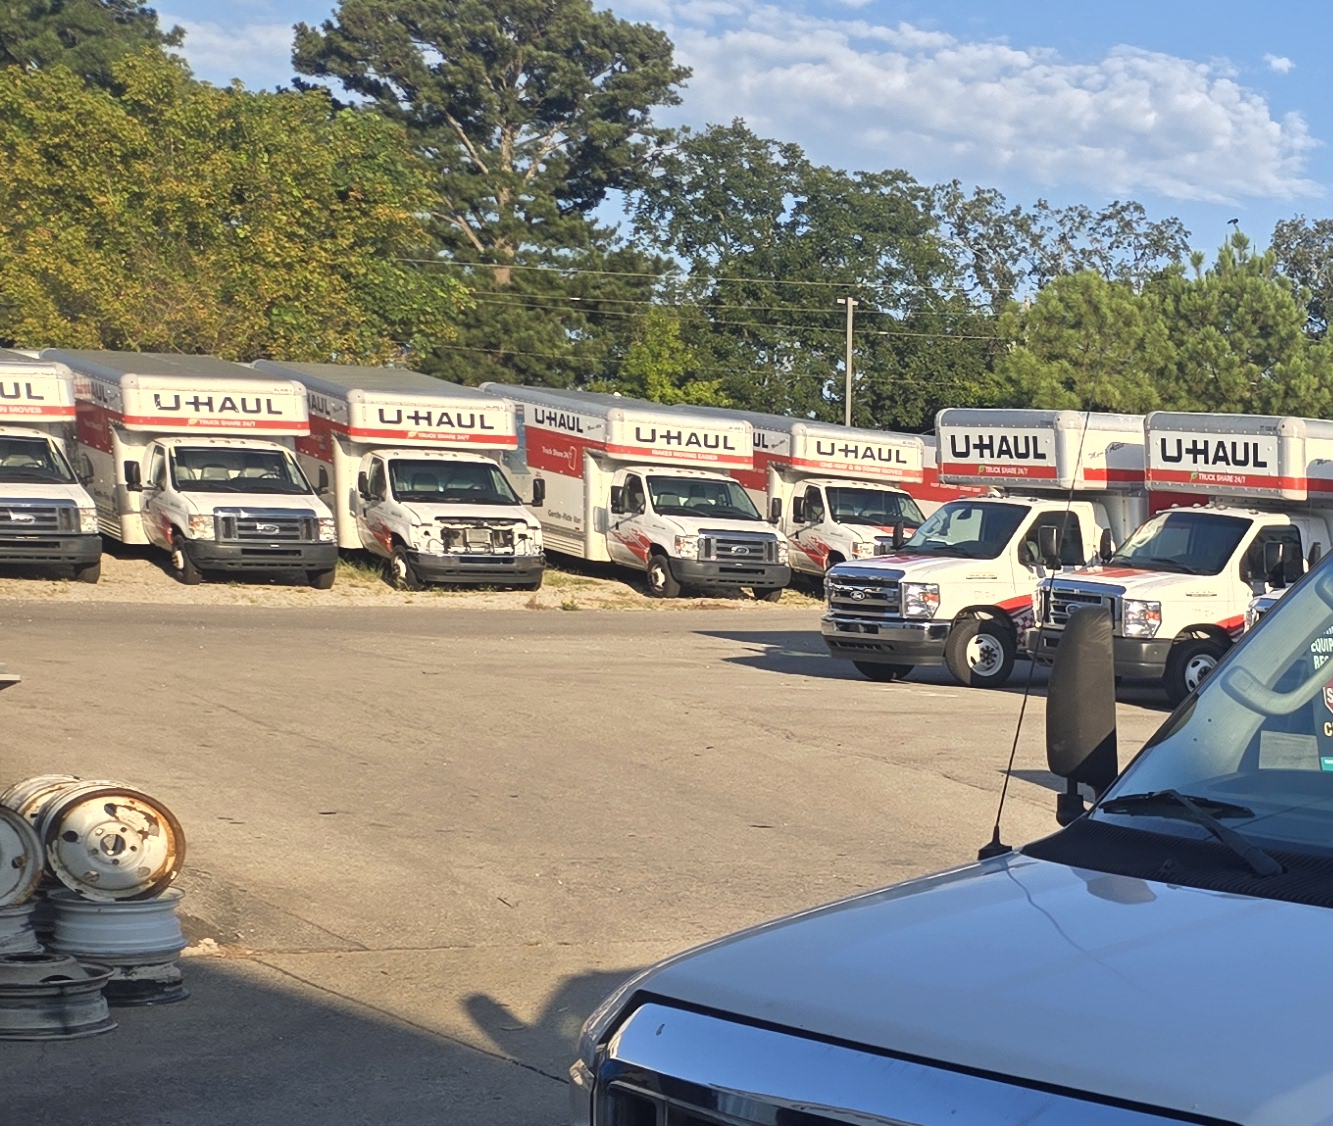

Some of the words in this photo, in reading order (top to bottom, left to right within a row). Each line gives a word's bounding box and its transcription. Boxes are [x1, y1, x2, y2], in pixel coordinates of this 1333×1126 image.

[154, 394, 283, 415] U-HAUL
[378, 409, 494, 430] U-HAUL
[534, 408, 583, 433] U-HAUL
[635, 427, 736, 451] U-HAUL
[950, 435, 1047, 460] U-HAUL
[816, 440, 908, 464] U-HAUL
[1160, 437, 1268, 468] U-HAUL
[985, 466, 1001, 474] TRUCK
[1198, 473, 1216, 481] TRUCK
[1216, 474, 1234, 483] SHARE
[1234, 475, 1246, 484] 24/7
